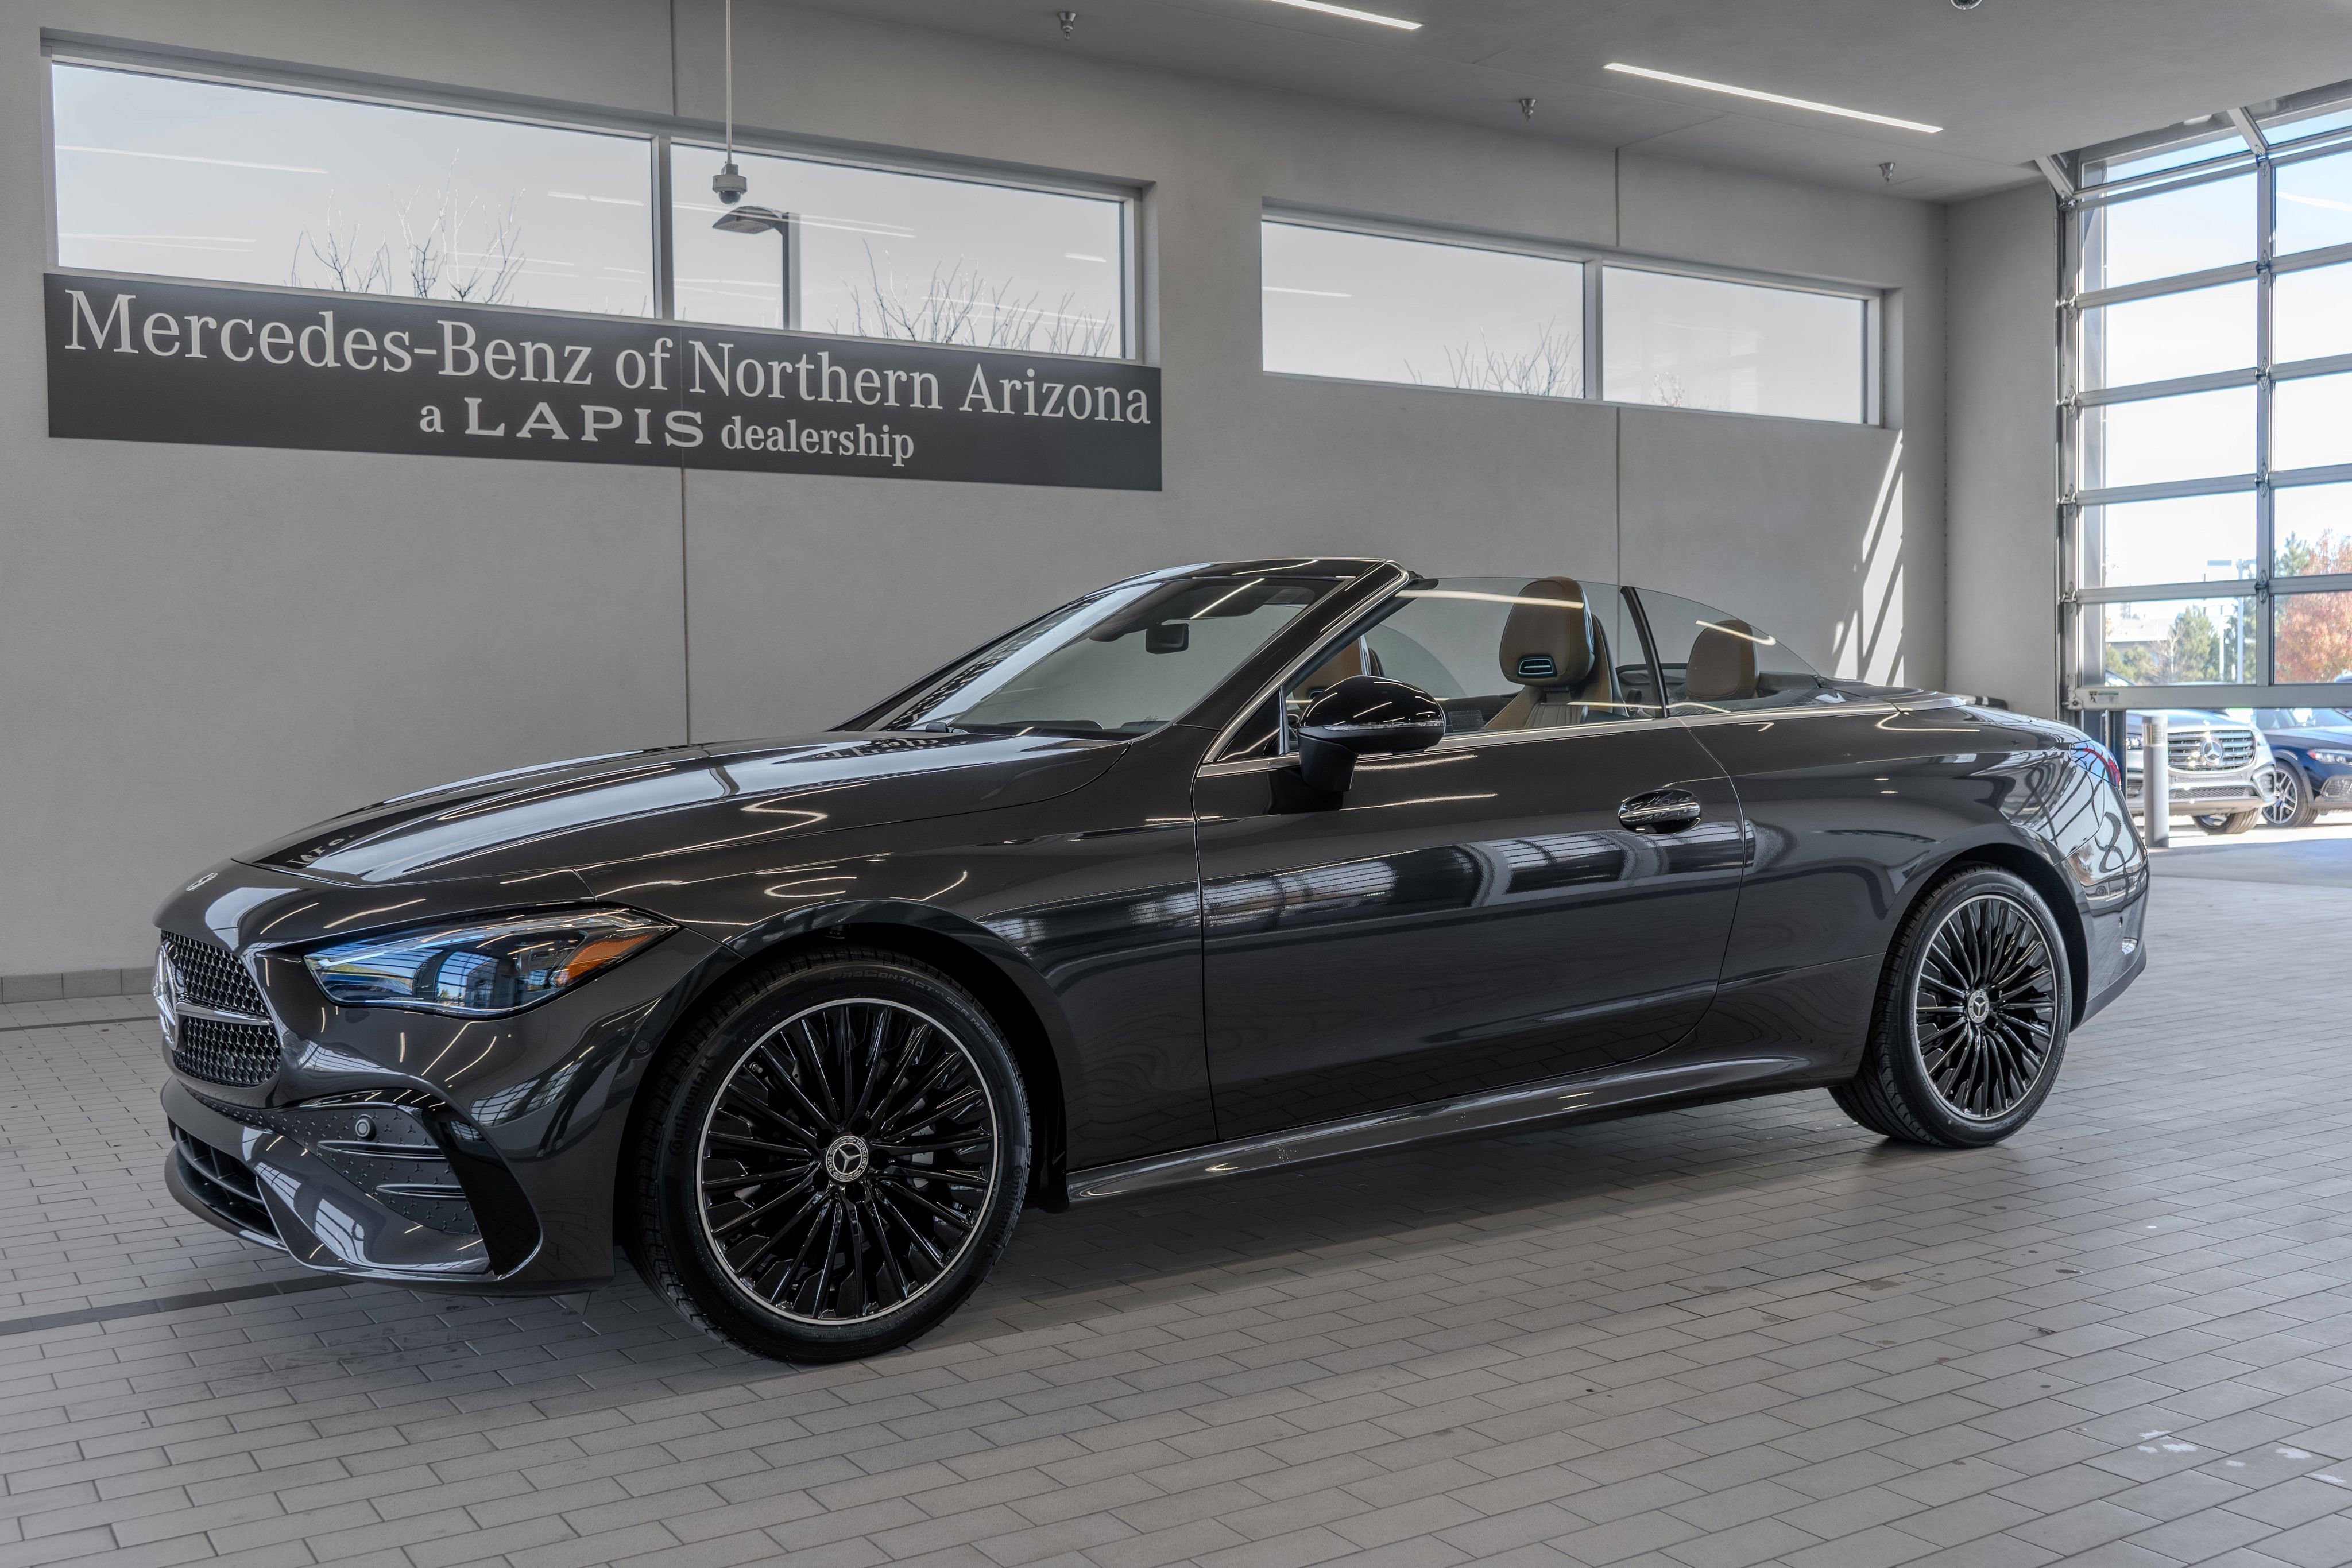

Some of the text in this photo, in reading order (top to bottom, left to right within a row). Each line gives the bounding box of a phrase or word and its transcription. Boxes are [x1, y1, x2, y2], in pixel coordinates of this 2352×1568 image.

[64, 289, 1151, 424] Mercedes-Benz of Northern Arizona
[419, 397, 914, 467] a LAPIS dealership
[945, 997, 969, 1016] SSR
[668, 1064, 711, 1157] Continental
[856, 1140, 868, 1170] MERCEDES
